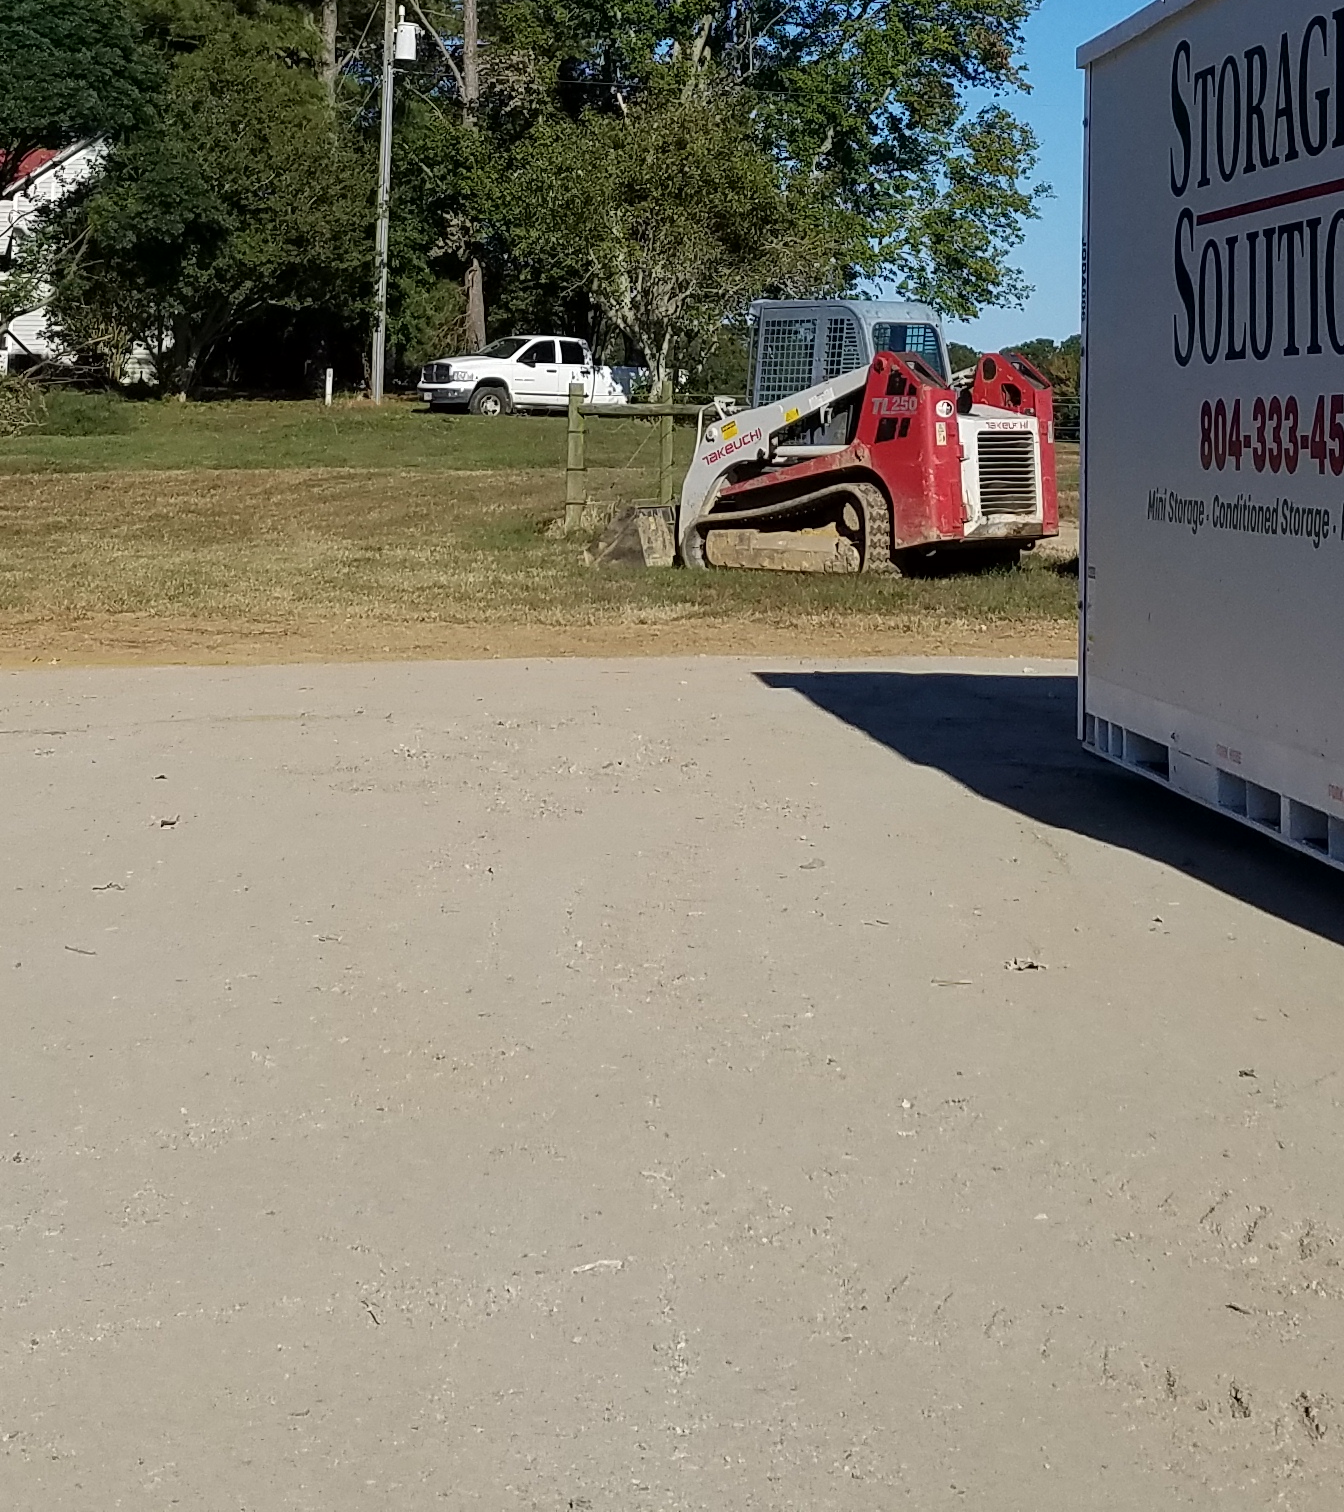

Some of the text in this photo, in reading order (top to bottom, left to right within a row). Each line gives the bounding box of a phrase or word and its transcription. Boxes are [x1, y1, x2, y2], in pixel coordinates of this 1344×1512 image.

[986, 420, 1029, 430] TAKEUHI
[1147, 487, 1168, 522] Mini
[1168, 491, 1205, 535] Storage
[1212, 494, 1280, 535] Conditioned
[1280, 498, 1330, 549] Storage
